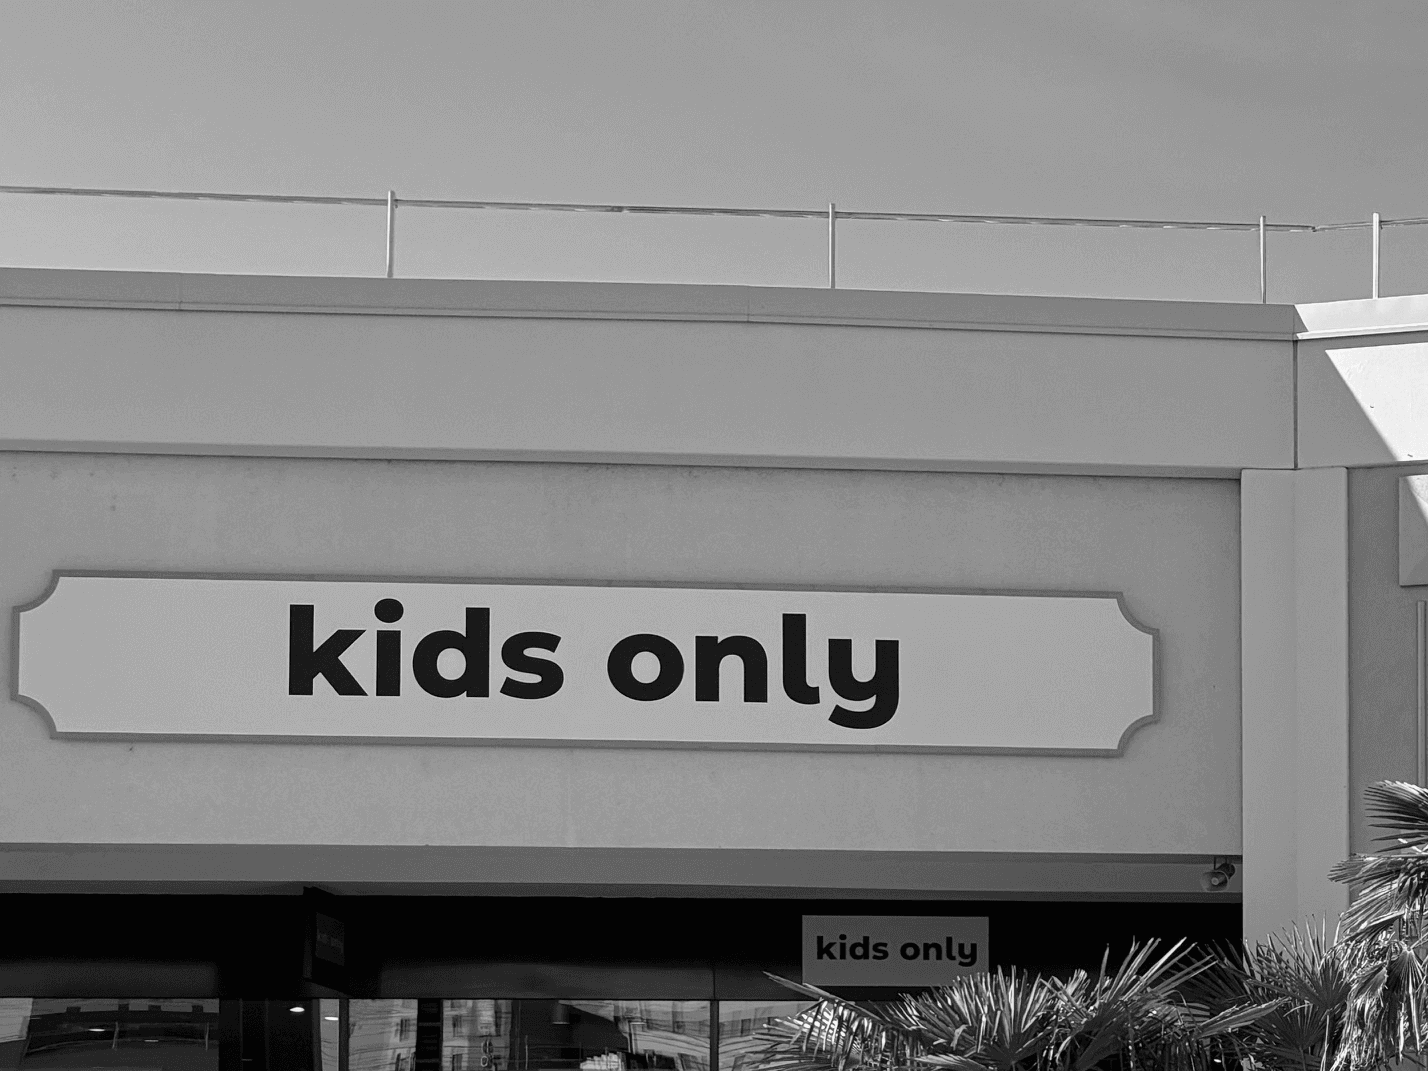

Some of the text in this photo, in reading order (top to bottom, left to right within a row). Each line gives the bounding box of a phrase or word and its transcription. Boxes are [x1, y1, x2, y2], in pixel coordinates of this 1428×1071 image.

[288, 598, 900, 730] kids only
[816, 933, 978, 968] kids only
